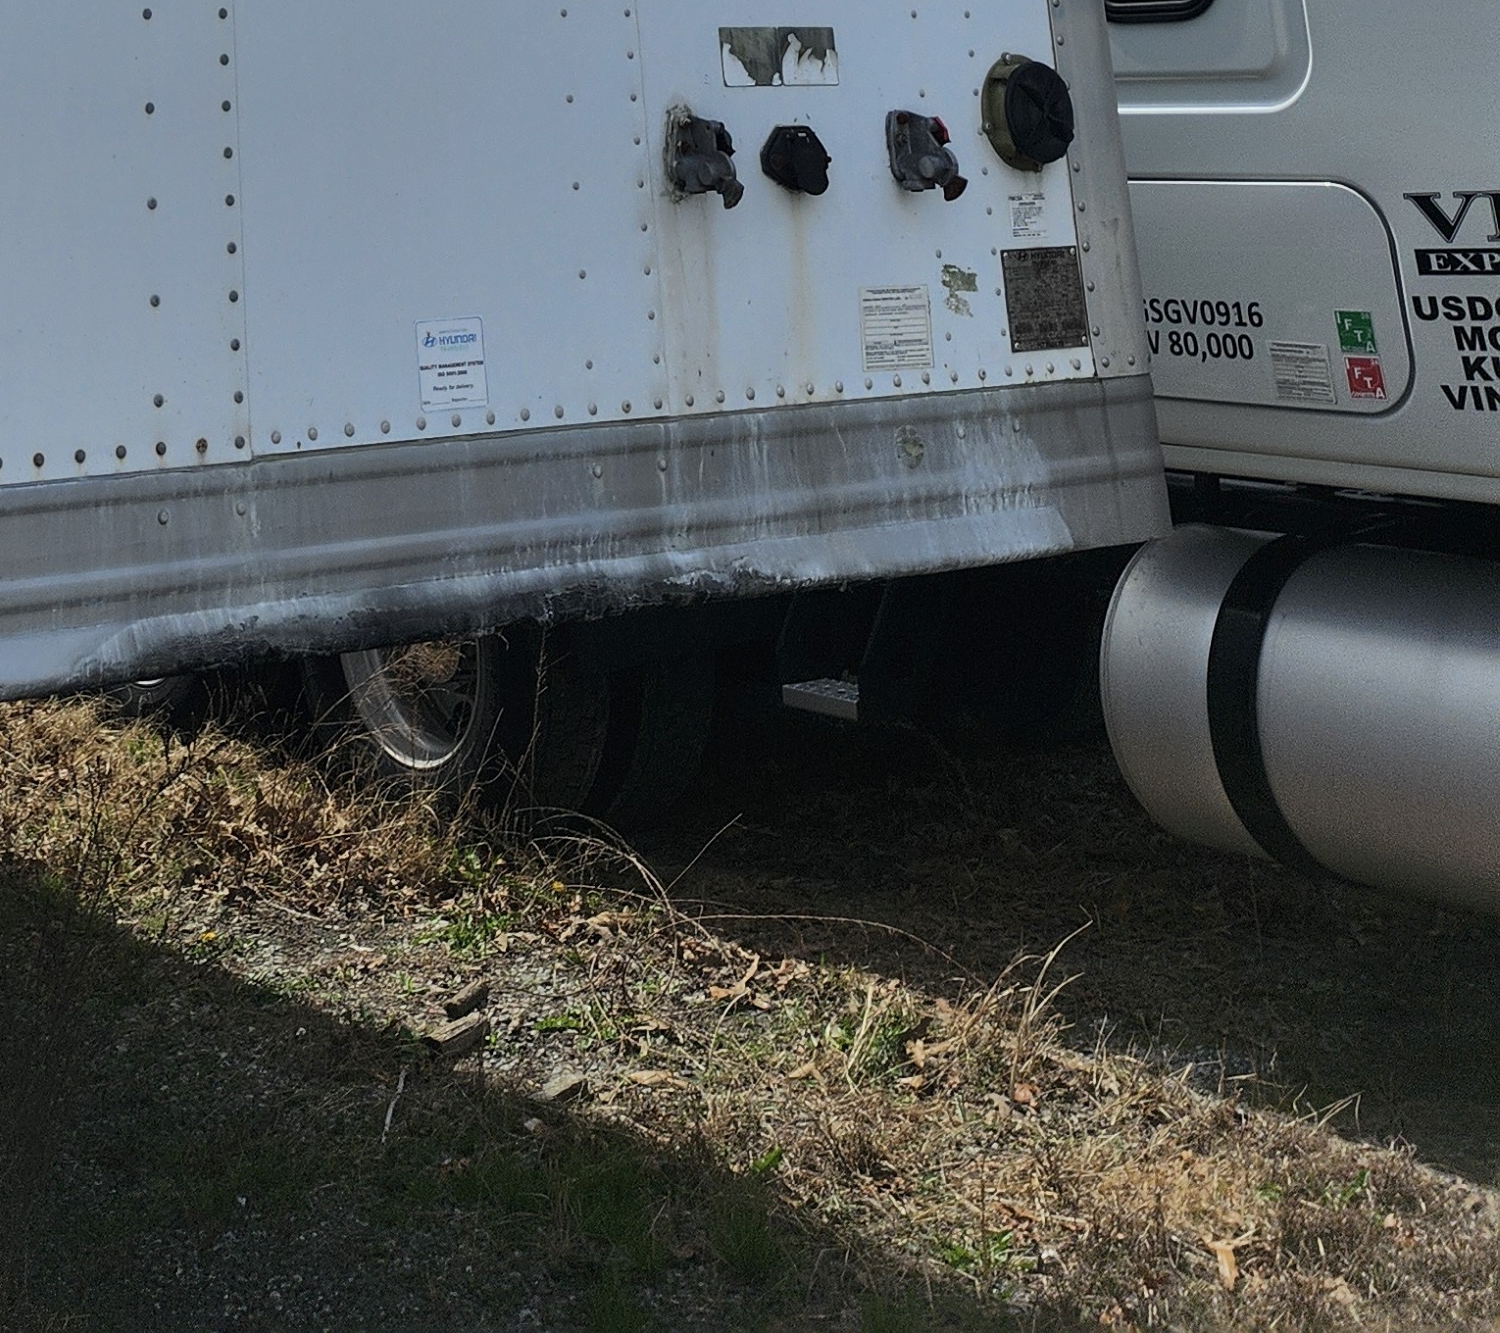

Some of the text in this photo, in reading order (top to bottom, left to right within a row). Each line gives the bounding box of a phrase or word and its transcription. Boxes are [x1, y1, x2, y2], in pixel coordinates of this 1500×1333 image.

[1428, 252, 1500, 272] EXP
[1411, 295, 1500, 322] USD
[439, 333, 477, 345] HYUNDAI
[1168, 330, 1254, 363] 80,000
